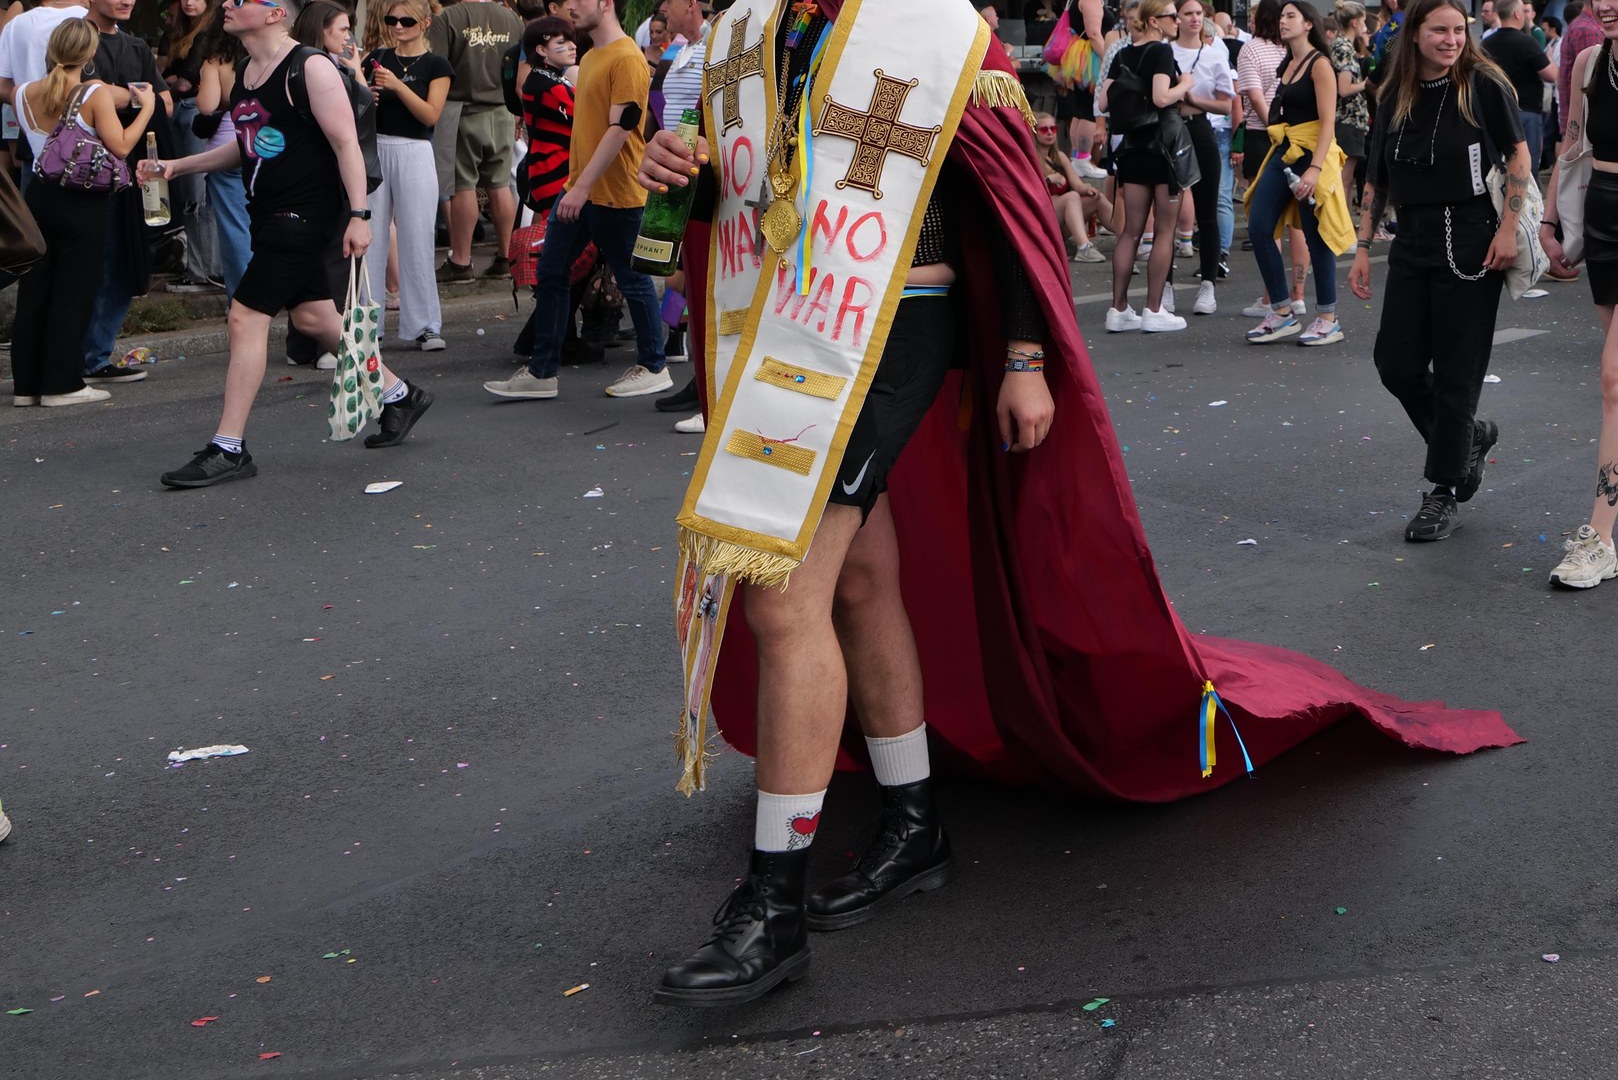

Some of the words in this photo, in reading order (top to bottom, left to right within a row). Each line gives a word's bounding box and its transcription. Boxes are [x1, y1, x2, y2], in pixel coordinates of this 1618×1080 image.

[721, 136, 754, 202] NO
[811, 199, 888, 263] NO
[774, 262, 877, 347] WAR
